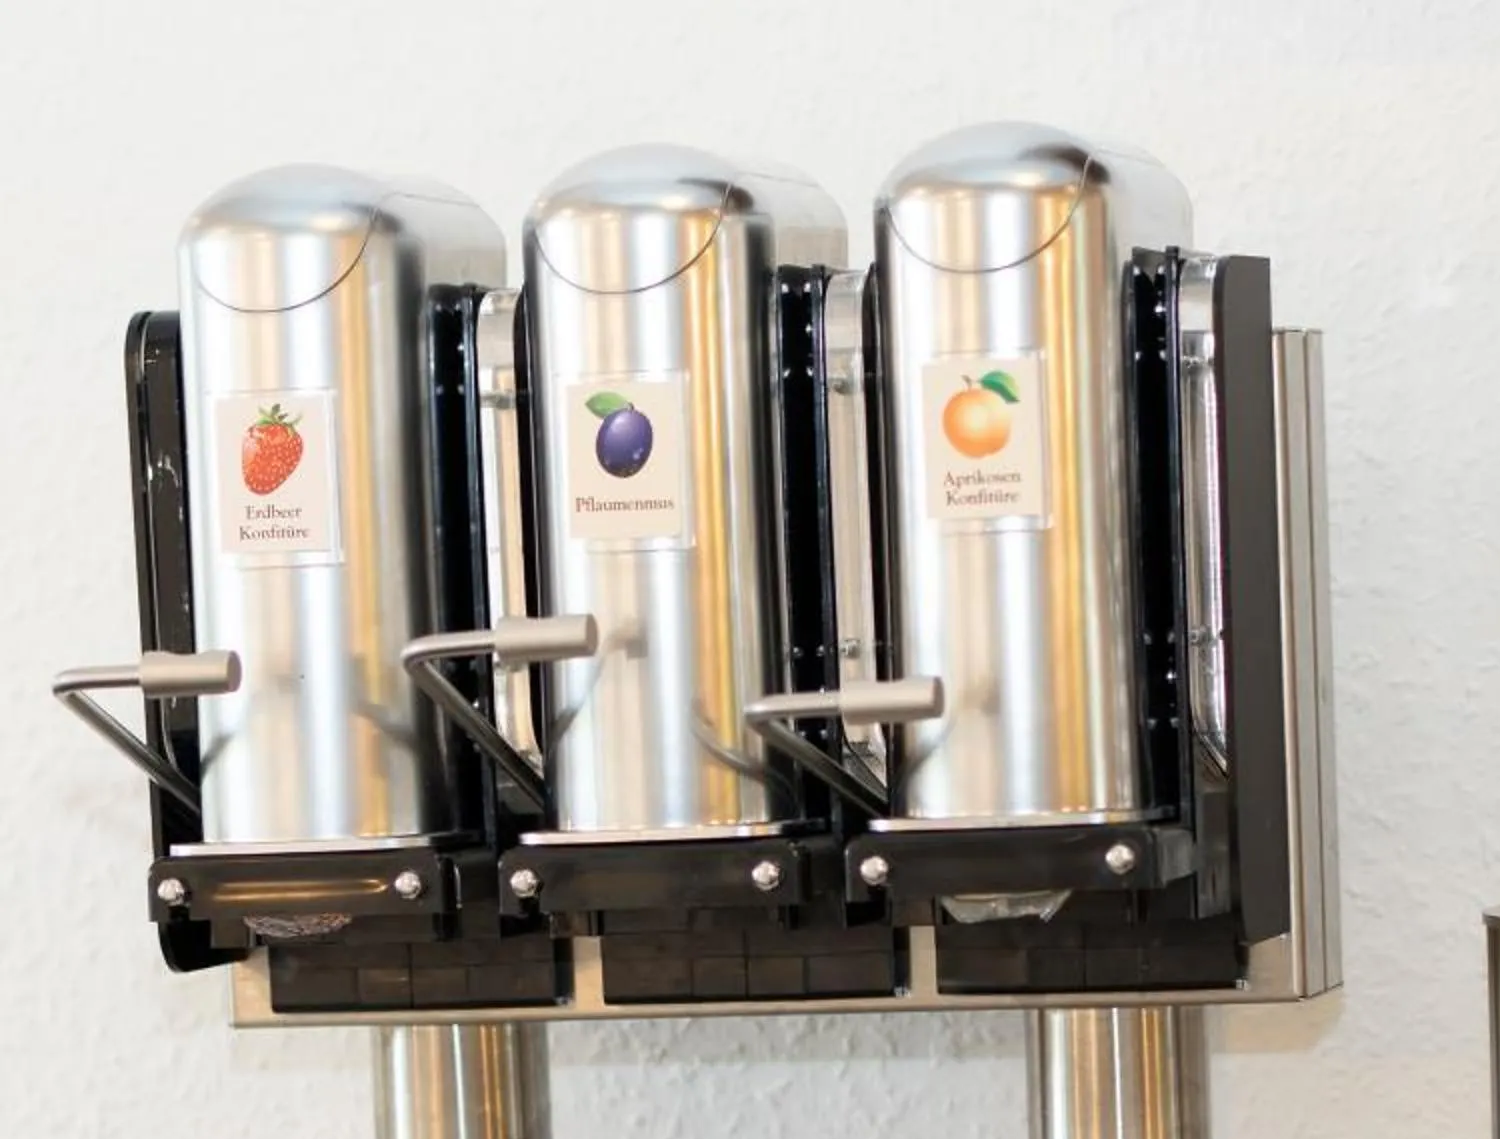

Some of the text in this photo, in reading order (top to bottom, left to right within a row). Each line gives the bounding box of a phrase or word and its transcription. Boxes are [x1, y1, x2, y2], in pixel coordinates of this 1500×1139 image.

[943, 468, 1021, 489] Aprikosen
[574, 496, 675, 513] Pflaumenmus
[945, 489, 1020, 506] Konfitüre
[245, 504, 302, 520] Erdbeer
[239, 523, 309, 541] Konfitüre
